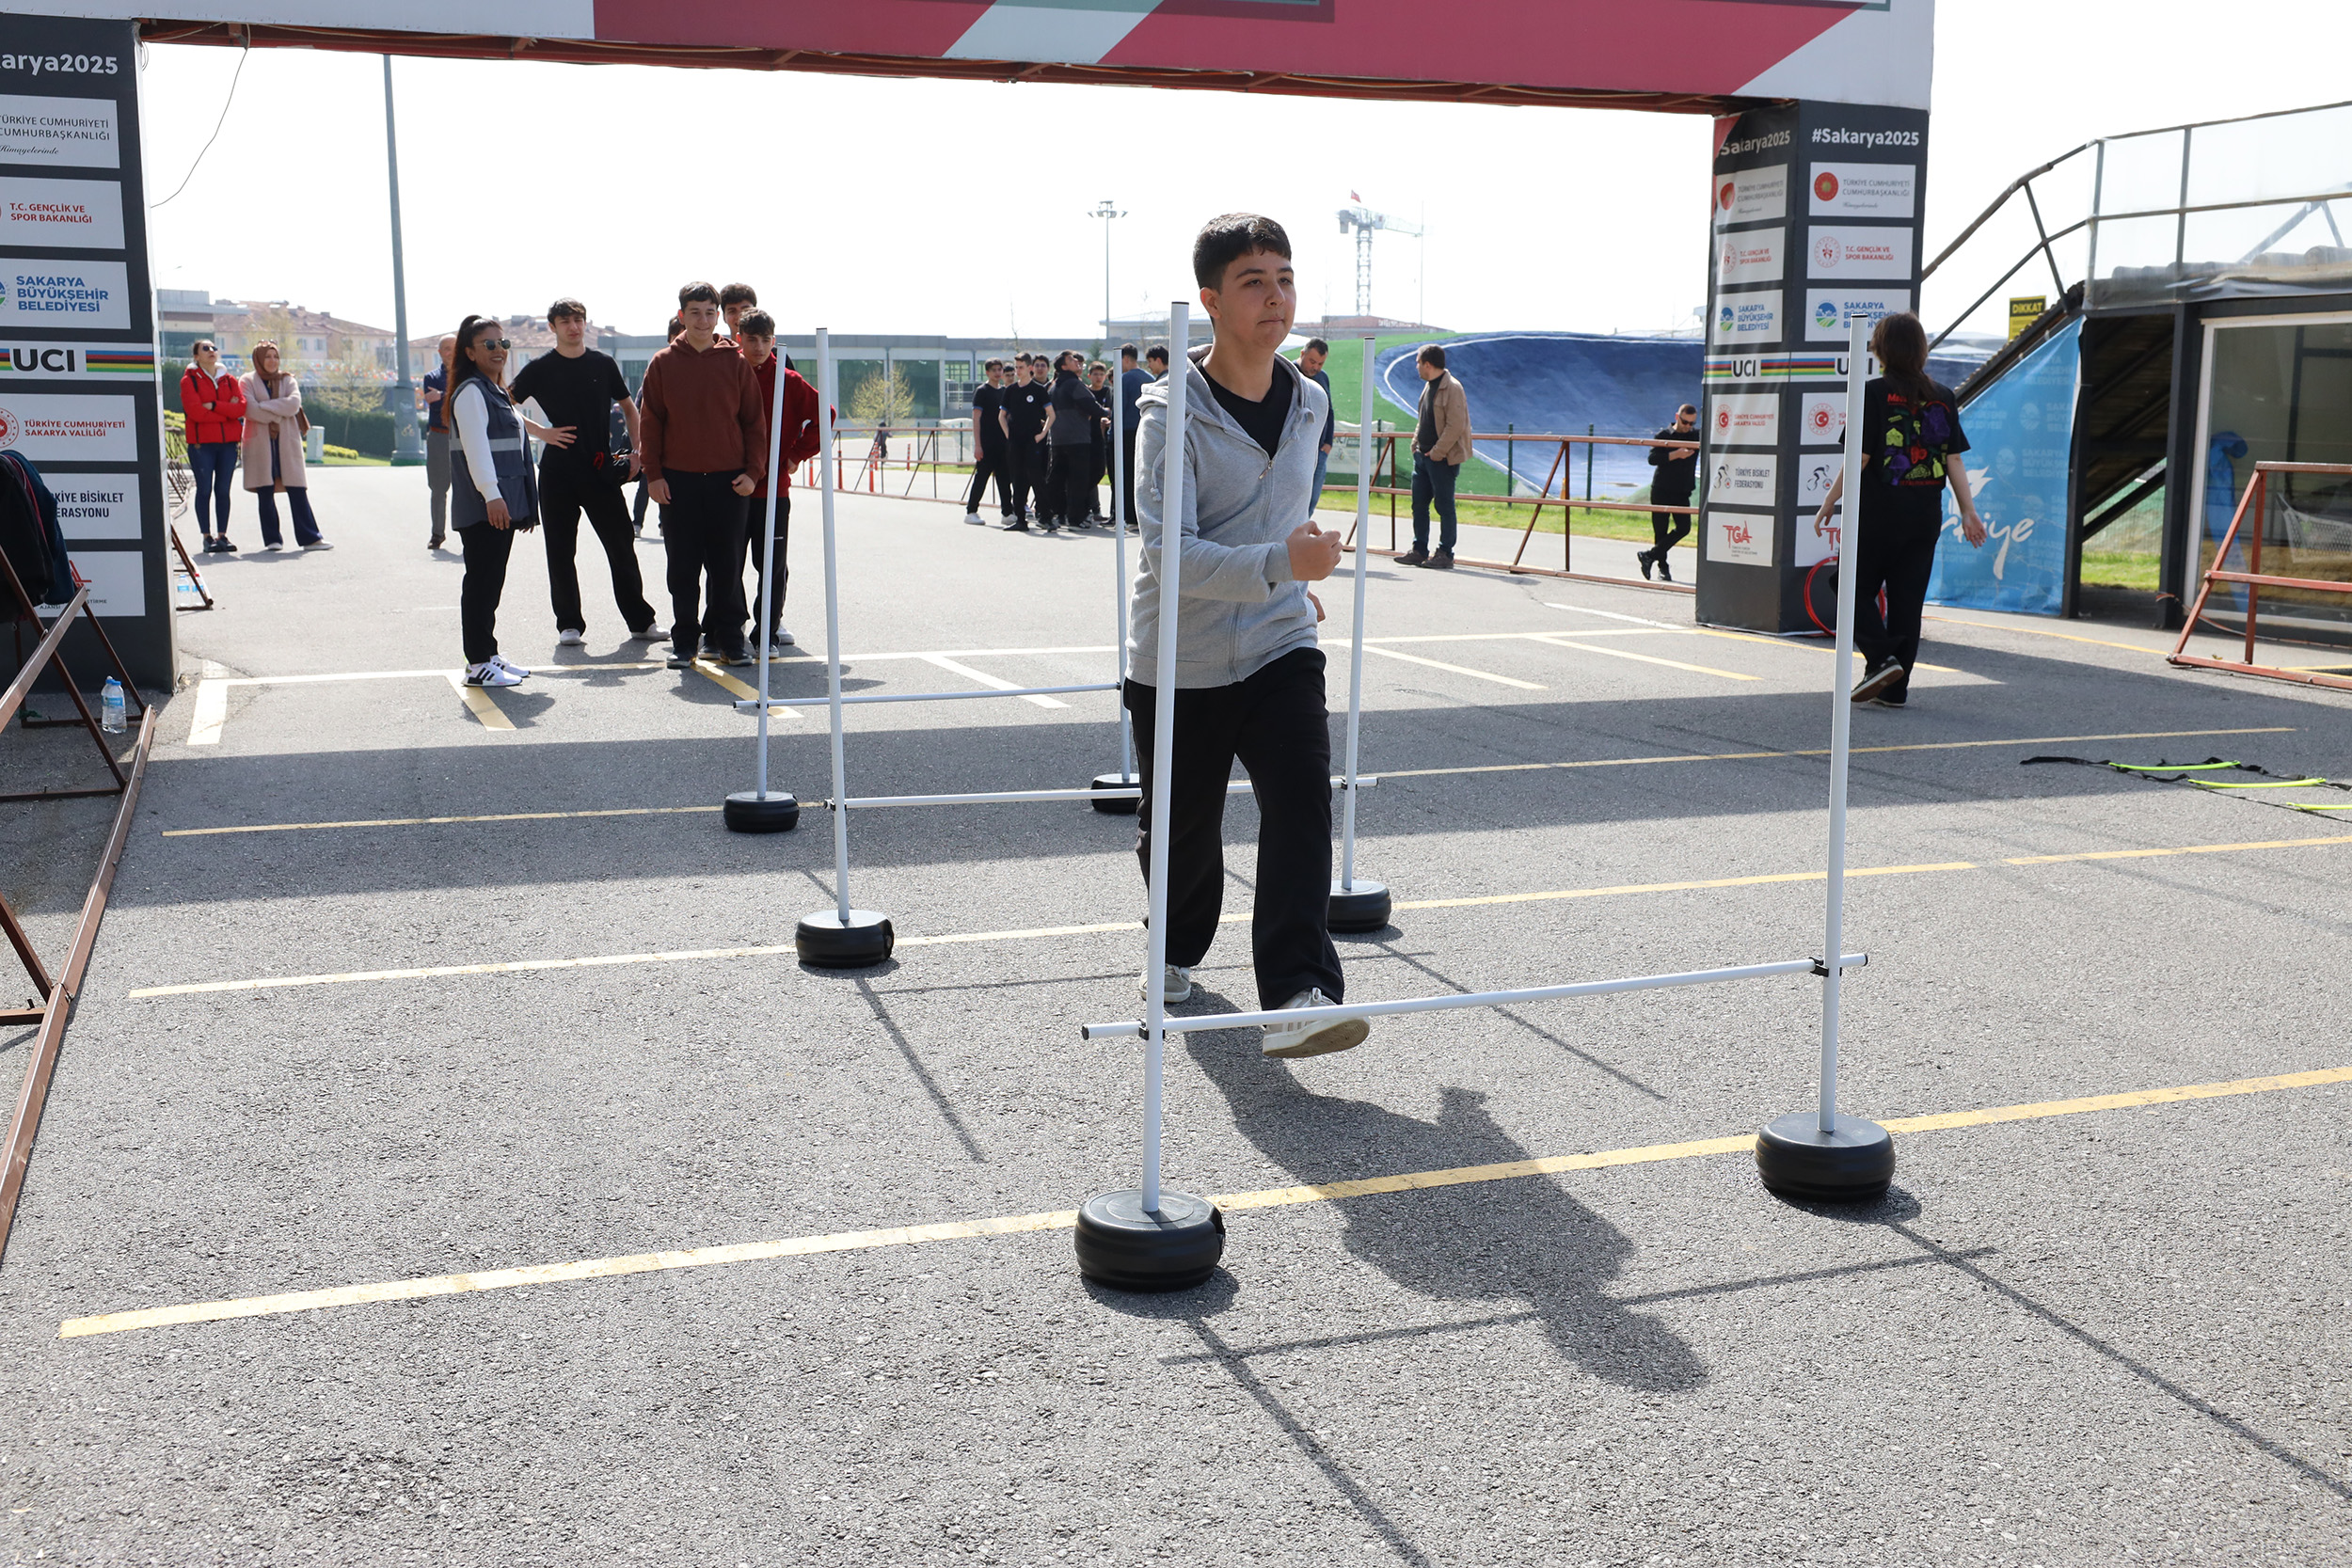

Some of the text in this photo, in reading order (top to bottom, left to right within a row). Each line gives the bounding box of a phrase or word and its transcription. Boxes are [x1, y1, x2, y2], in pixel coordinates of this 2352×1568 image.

[0, 54, 119, 76] arya2025
[0, 114, 109, 129] ÜRKİYE CUMHURİYETİ
[1811, 128, 1920, 149] #Sakarya2025
[9, 202, 27, 212] T.C.
[29, 203, 71, 214] GENÇLİK
[10, 213, 92, 223] SPOR BAKANLIĞI
[16, 276, 85, 287] SAKARYA
[17, 286, 109, 300] BÜYÜKŞEHİR
[18, 300, 101, 313] BELEDİYESİ
[1738, 304, 1765, 312] SAKARYA
[13, 348, 75, 372] UCI
[1836, 357, 1873, 375] UI
[1733, 359, 1756, 377] UCI
[24, 419, 125, 429] TÜRKİYE CUMHURİYETİ
[70, 429, 106, 437] VALİLİĞİ
[55, 490, 124, 503] KİYE BİSİKLET
[56, 507, 110, 518] ERASYONU
[1723, 520, 1753, 549] TGA
